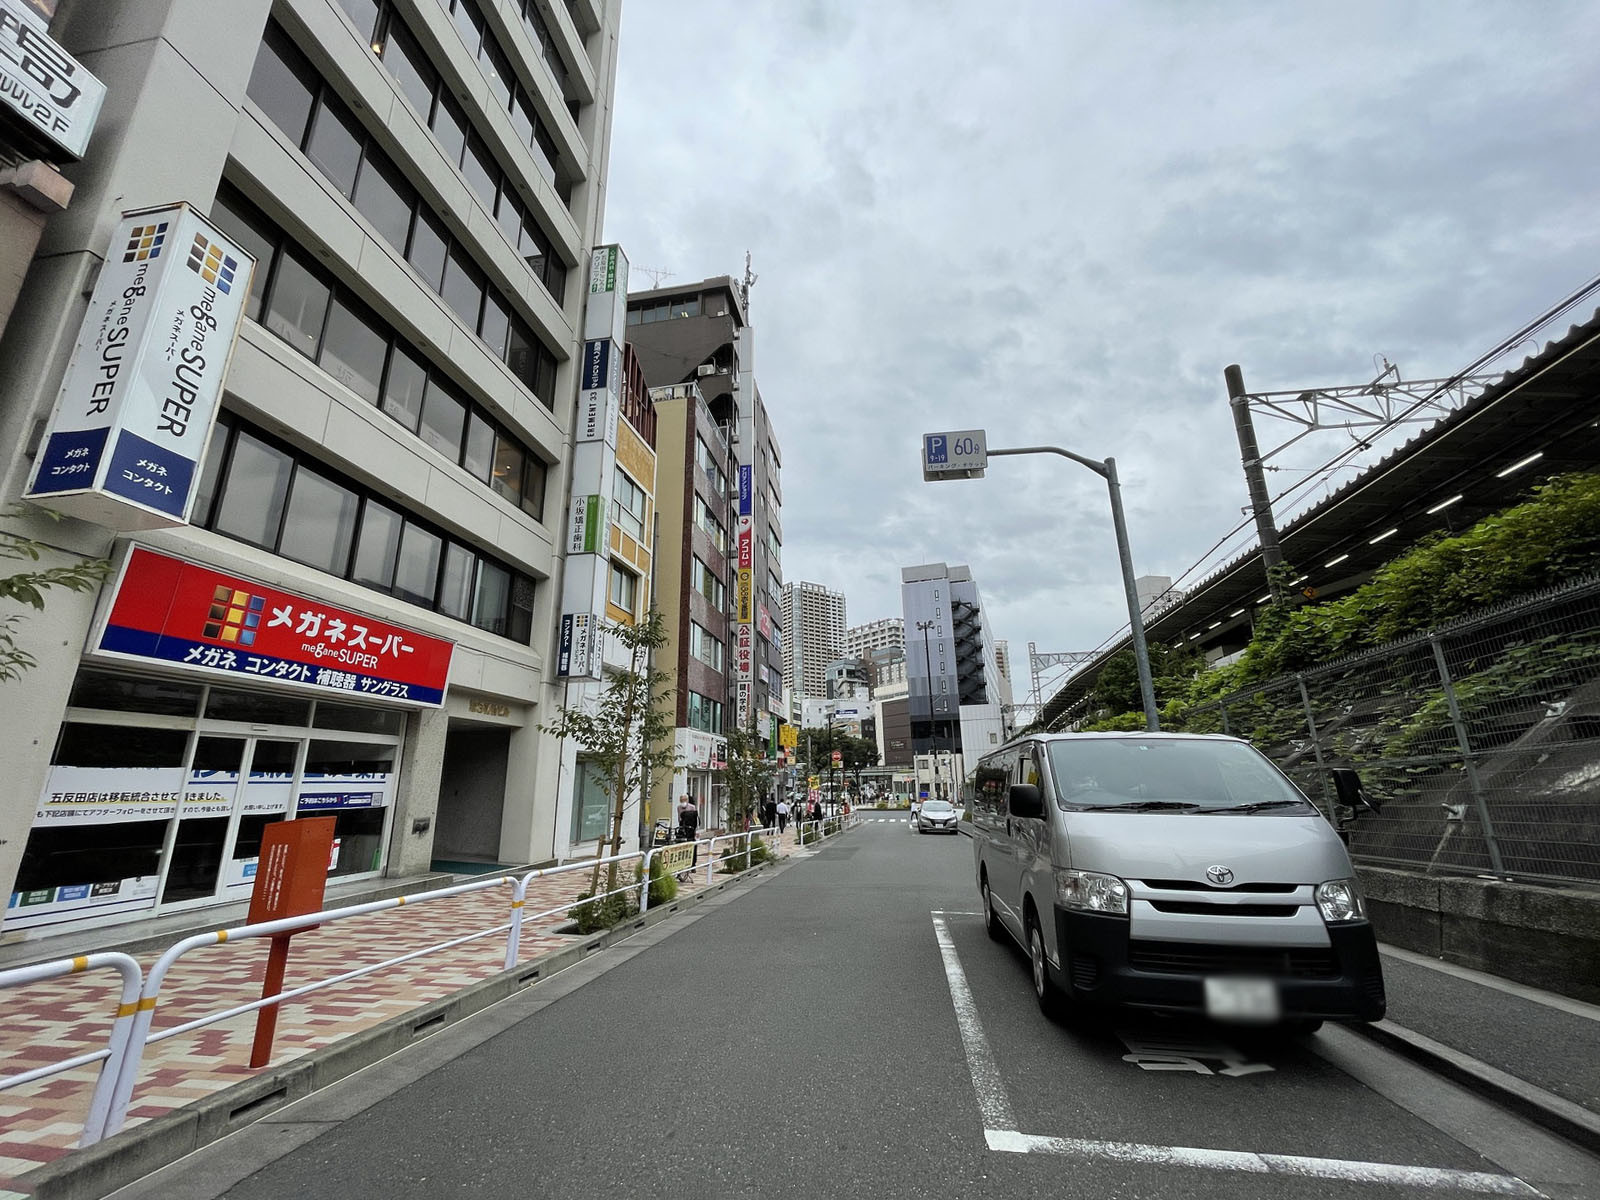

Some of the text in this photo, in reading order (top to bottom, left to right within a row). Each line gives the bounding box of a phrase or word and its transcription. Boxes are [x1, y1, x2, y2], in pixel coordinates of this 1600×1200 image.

[587, 391, 598, 438] EREMENT 33
[64, 447, 90, 460] メガネ
[931, 437, 942, 454] P
[50, 461, 91, 476] コンタクト
[122, 469, 174, 496] コンタクト
[136, 457, 168, 478] メガネ
[266, 605, 415, 658] メガネスーパー
[739, 625, 750, 673] 公証役場
[578, 628, 588, 673] メガネスーパー
[183, 645, 410, 699] メガネ コンタクト 補聴器 サングラス
